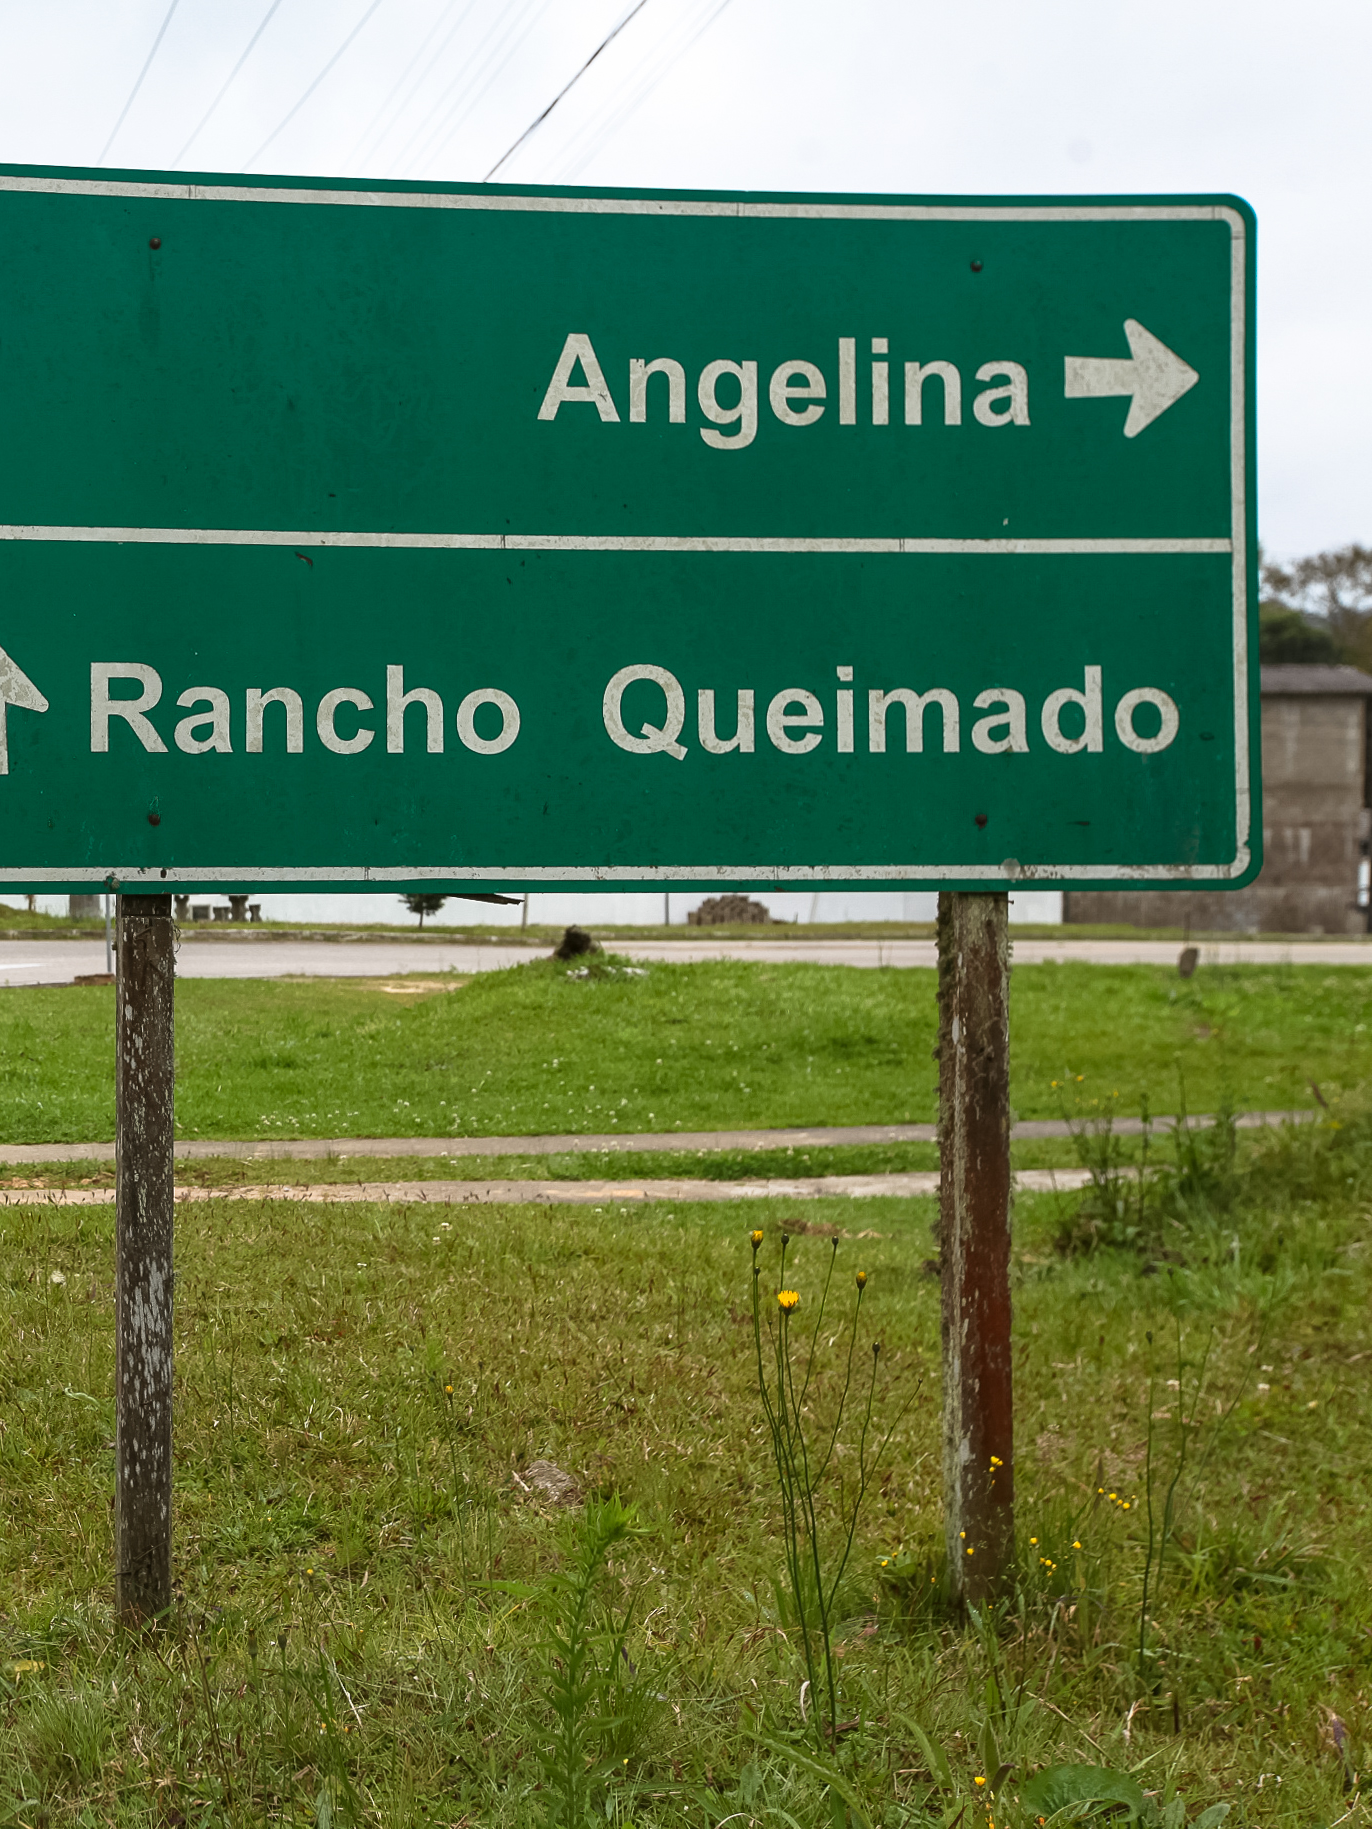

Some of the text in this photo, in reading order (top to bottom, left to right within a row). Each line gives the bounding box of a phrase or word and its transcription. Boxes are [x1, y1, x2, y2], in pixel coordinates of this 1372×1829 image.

[537, 333, 1031, 450] Angelina
[90, 661, 1179, 761] Rancho Queimado
